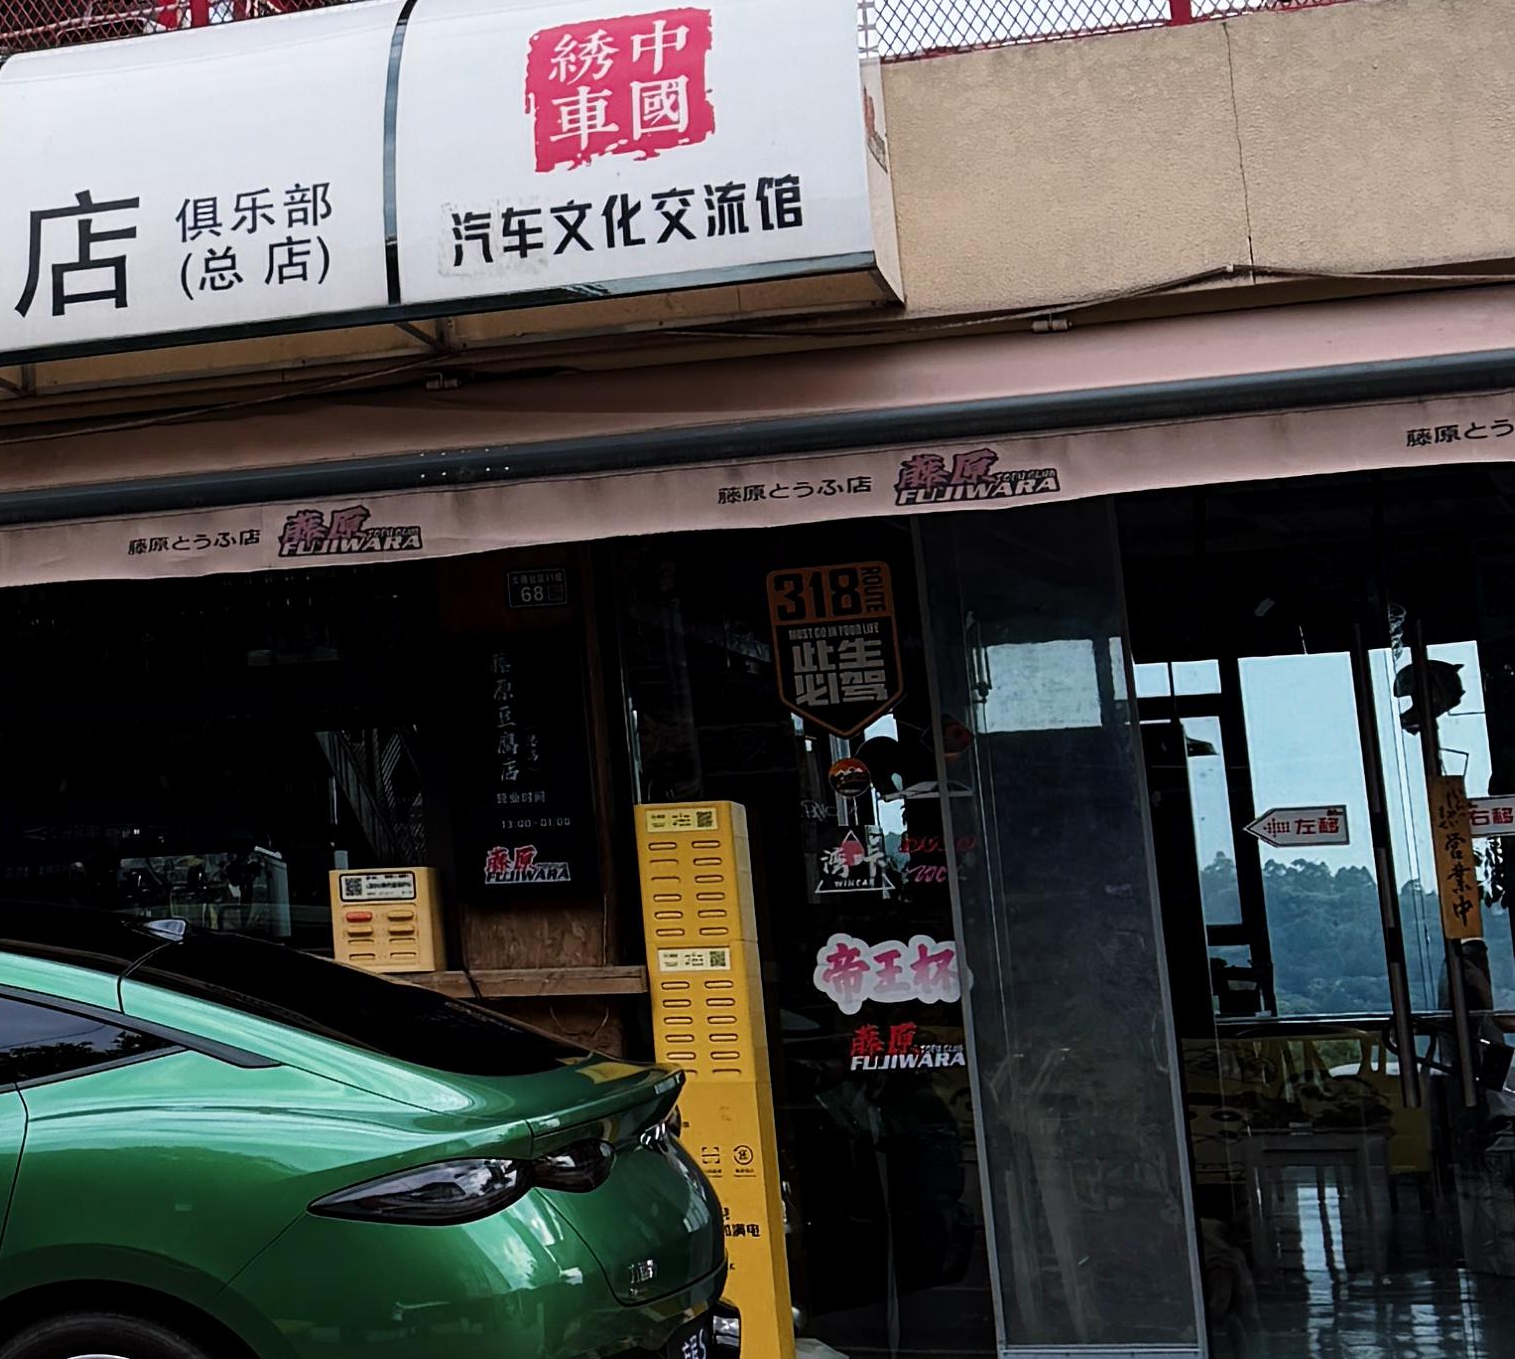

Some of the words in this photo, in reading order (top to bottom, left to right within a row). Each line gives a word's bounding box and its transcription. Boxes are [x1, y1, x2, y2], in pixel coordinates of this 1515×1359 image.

[176, 182, 332, 242] 俱乐部
[452, 174, 803, 266] 汽车文化交流馆
[180, 235, 330, 301] (总店)
[718, 476, 872, 504] 藤原とうふ店
[896, 477, 1060, 505] FUJIWARA
[128, 529, 260, 555] 藤原とうふ店
[280, 534, 422, 557] FUJIWARA
[520, 585, 545, 603] 68
[774, 569, 861, 621] 318
[861, 567, 886, 612] ROUTE
[792, 638, 885, 673] 此生
[794, 670, 888, 706] 必驾
[823, 943, 960, 1002] 帝王杯
[851, 1022, 919, 1055] 藤原
[850, 1052, 966, 1071] FUJIWARA
